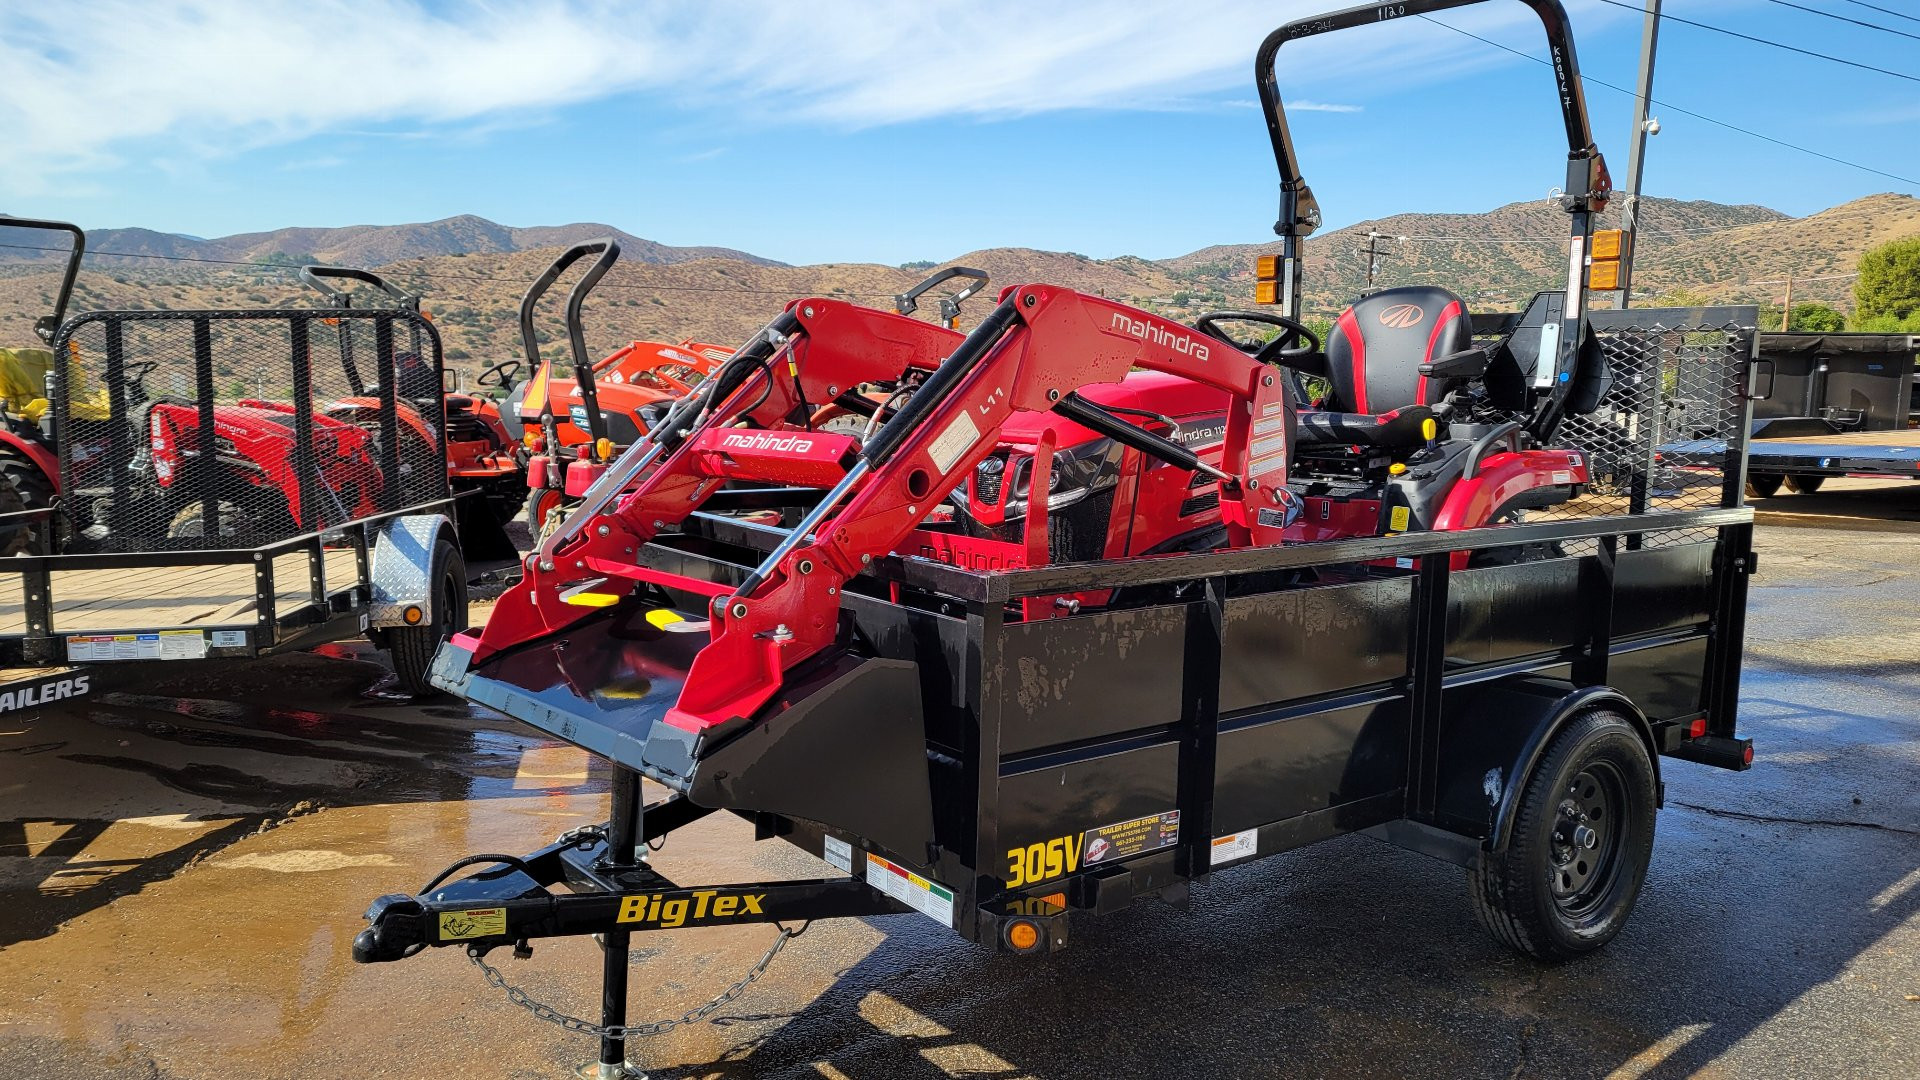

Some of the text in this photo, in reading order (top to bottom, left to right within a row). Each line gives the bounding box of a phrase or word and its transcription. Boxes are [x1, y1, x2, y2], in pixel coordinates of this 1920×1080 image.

[1379, 5, 1405, 20] 1120
[1112, 312, 1210, 361] mahindra
[980, 386, 1003, 415] L11
[722, 433, 813, 453] mahindra
[1179, 425, 1226, 443] indra 112
[920, 545, 1025, 570] mahindr
[0, 675, 90, 713] AILERS
[1099, 817, 1159, 836] TRAILER SUPER STORE
[1006, 832, 1084, 889] 30SV
